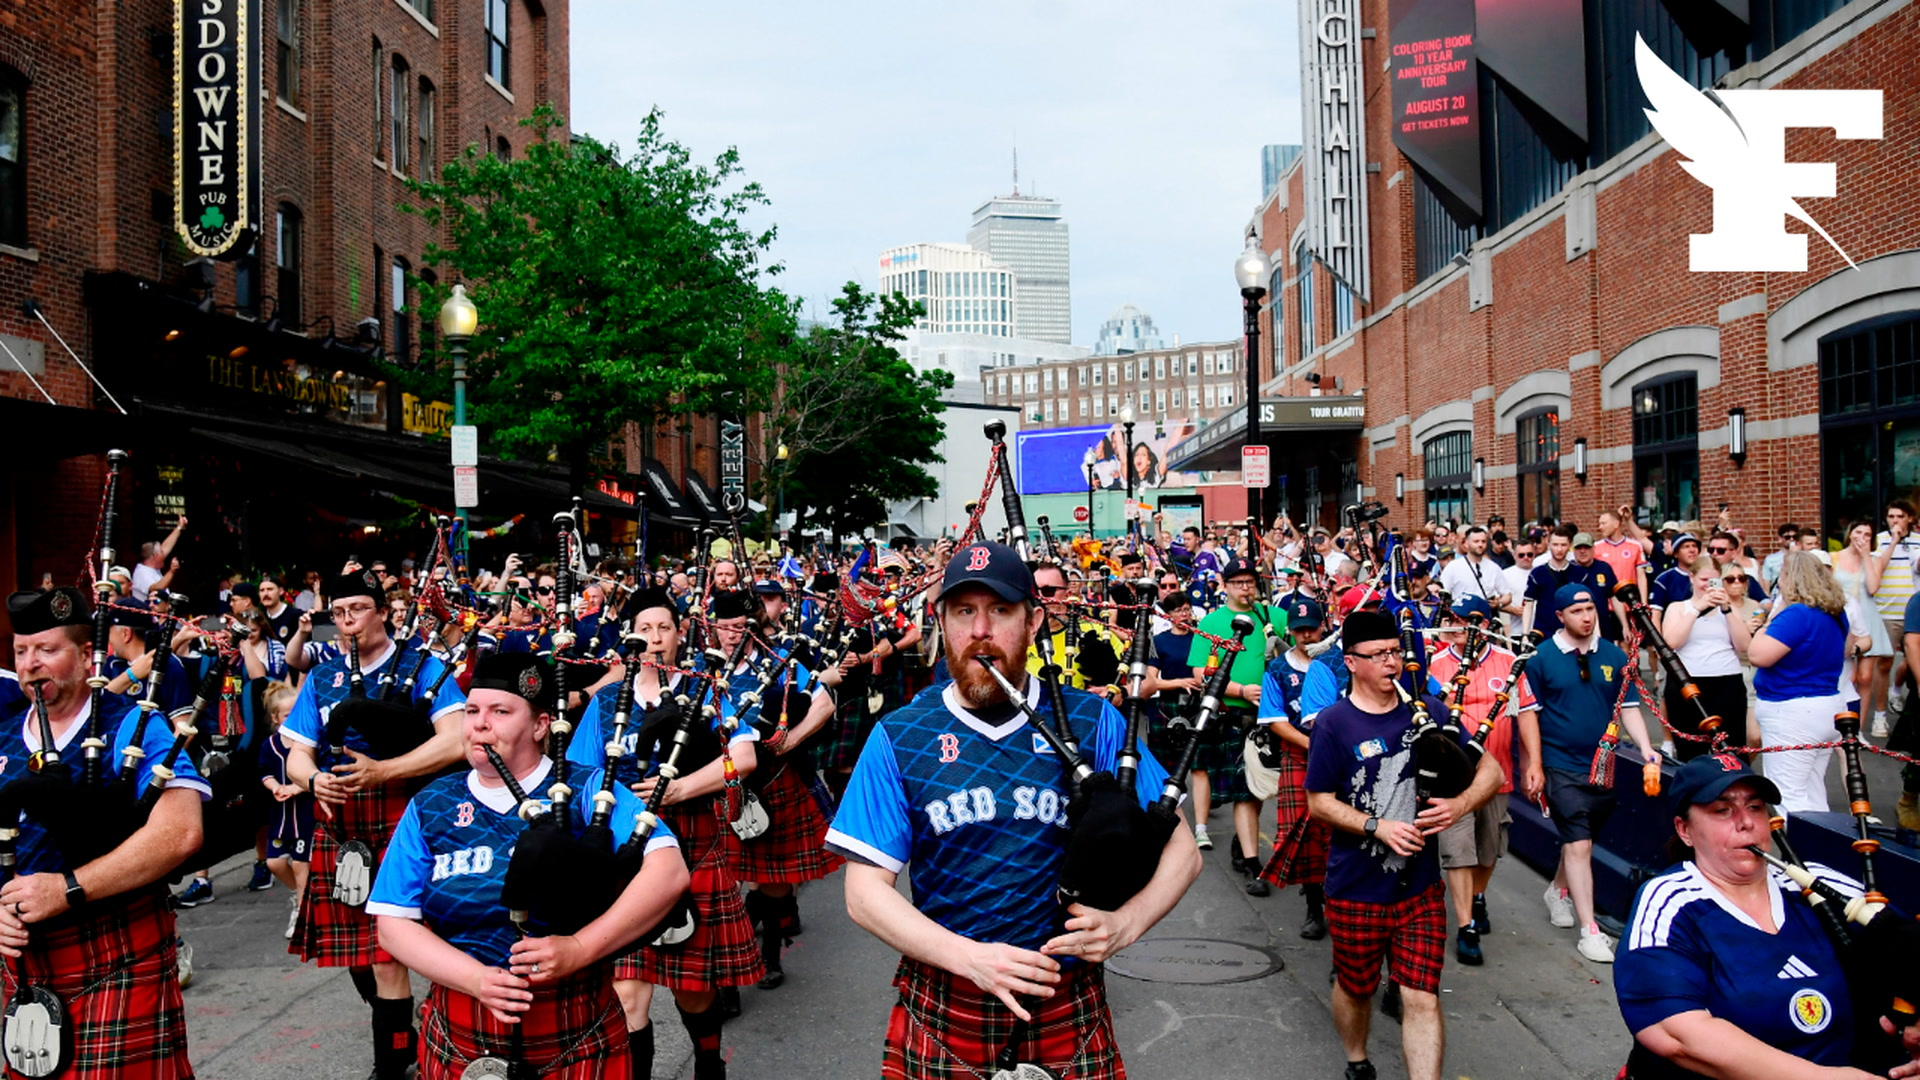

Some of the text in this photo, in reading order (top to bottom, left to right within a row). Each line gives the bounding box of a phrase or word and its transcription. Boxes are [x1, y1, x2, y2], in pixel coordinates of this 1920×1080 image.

[1392, 34, 1473, 57] COLORING BOOK
[1414, 49, 1454, 65] 10 YEAR
[1397, 60, 1468, 80] ANNIVERSARY
[1420, 75, 1447, 88] TOUR
[1405, 95, 1466, 115] AUGUST 20
[1401, 115, 1470, 133] GET TICKETS NOW
[199, 191, 228, 206] PUB
[190, 222, 235, 248] MUSIC
[206, 354, 351, 413] THE LANSDOWNE
[1310, 407, 1331, 418] TOUR
[720, 419, 745, 513] CHEEKY
[1074, 510, 1089, 518] STOP
[965, 546, 992, 572] B
[1298, 603, 1308, 617] B
[332, 671, 345, 688] B
[1288, 673, 1300, 687] B
[938, 733, 960, 763] B
[1712, 754, 1742, 772] B
[453, 801, 475, 828] B
[924, 785, 997, 837] RED
[295, 839, 306, 855] 8
[431, 845, 494, 883] RED
